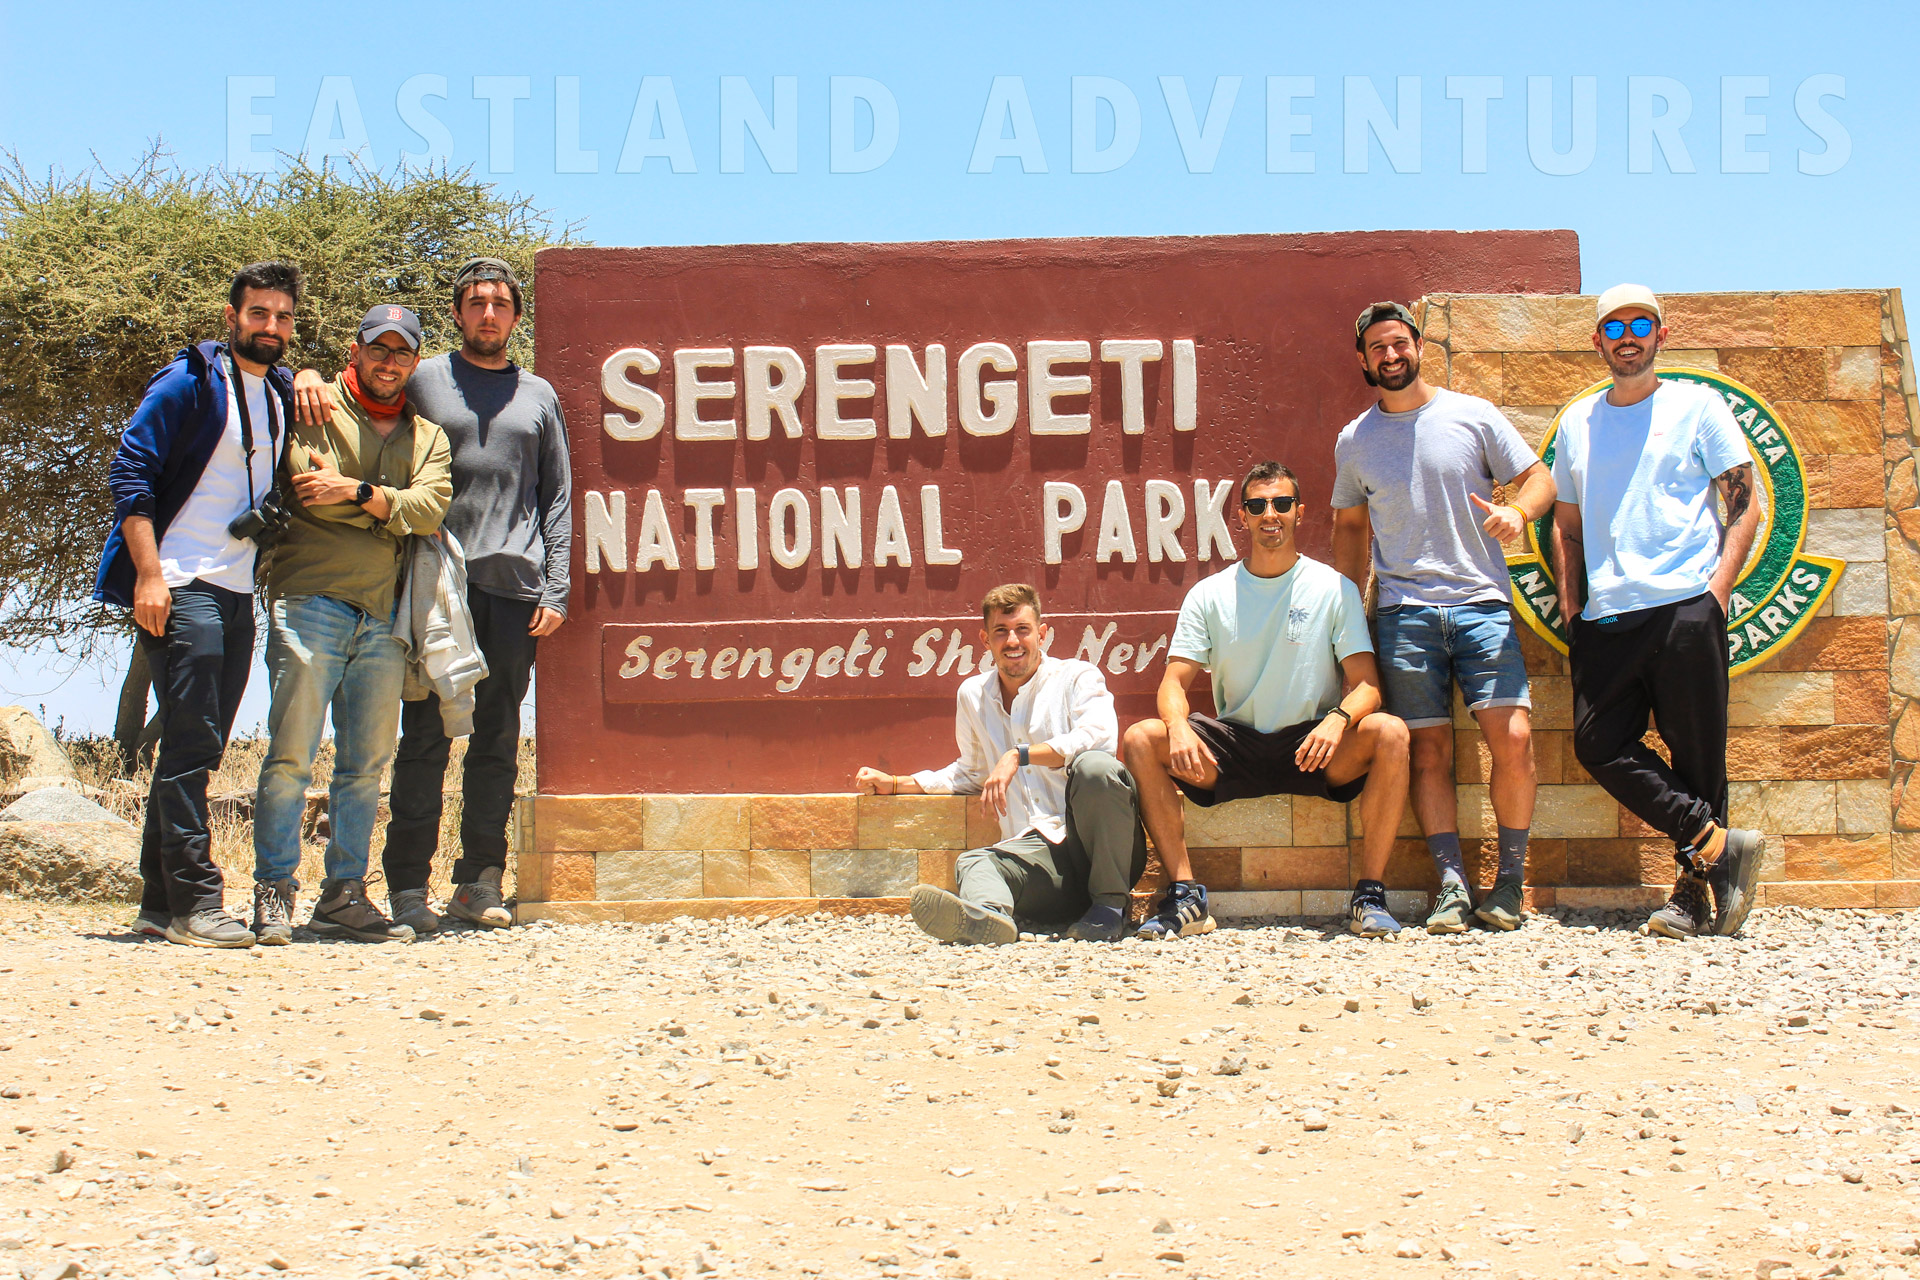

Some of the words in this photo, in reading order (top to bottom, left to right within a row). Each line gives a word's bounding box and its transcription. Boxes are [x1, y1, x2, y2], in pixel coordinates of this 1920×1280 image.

[386, 307, 402, 321] B
[602, 339, 1198, 441] SERENGETI
[1726, 392, 1788, 466] TAIFA
[585, 484, 963, 573] NATIONAL
[1044, 479, 1238, 565] PARK
[1728, 567, 1821, 661] PARKS
[619, 628, 894, 693] Serengeti
